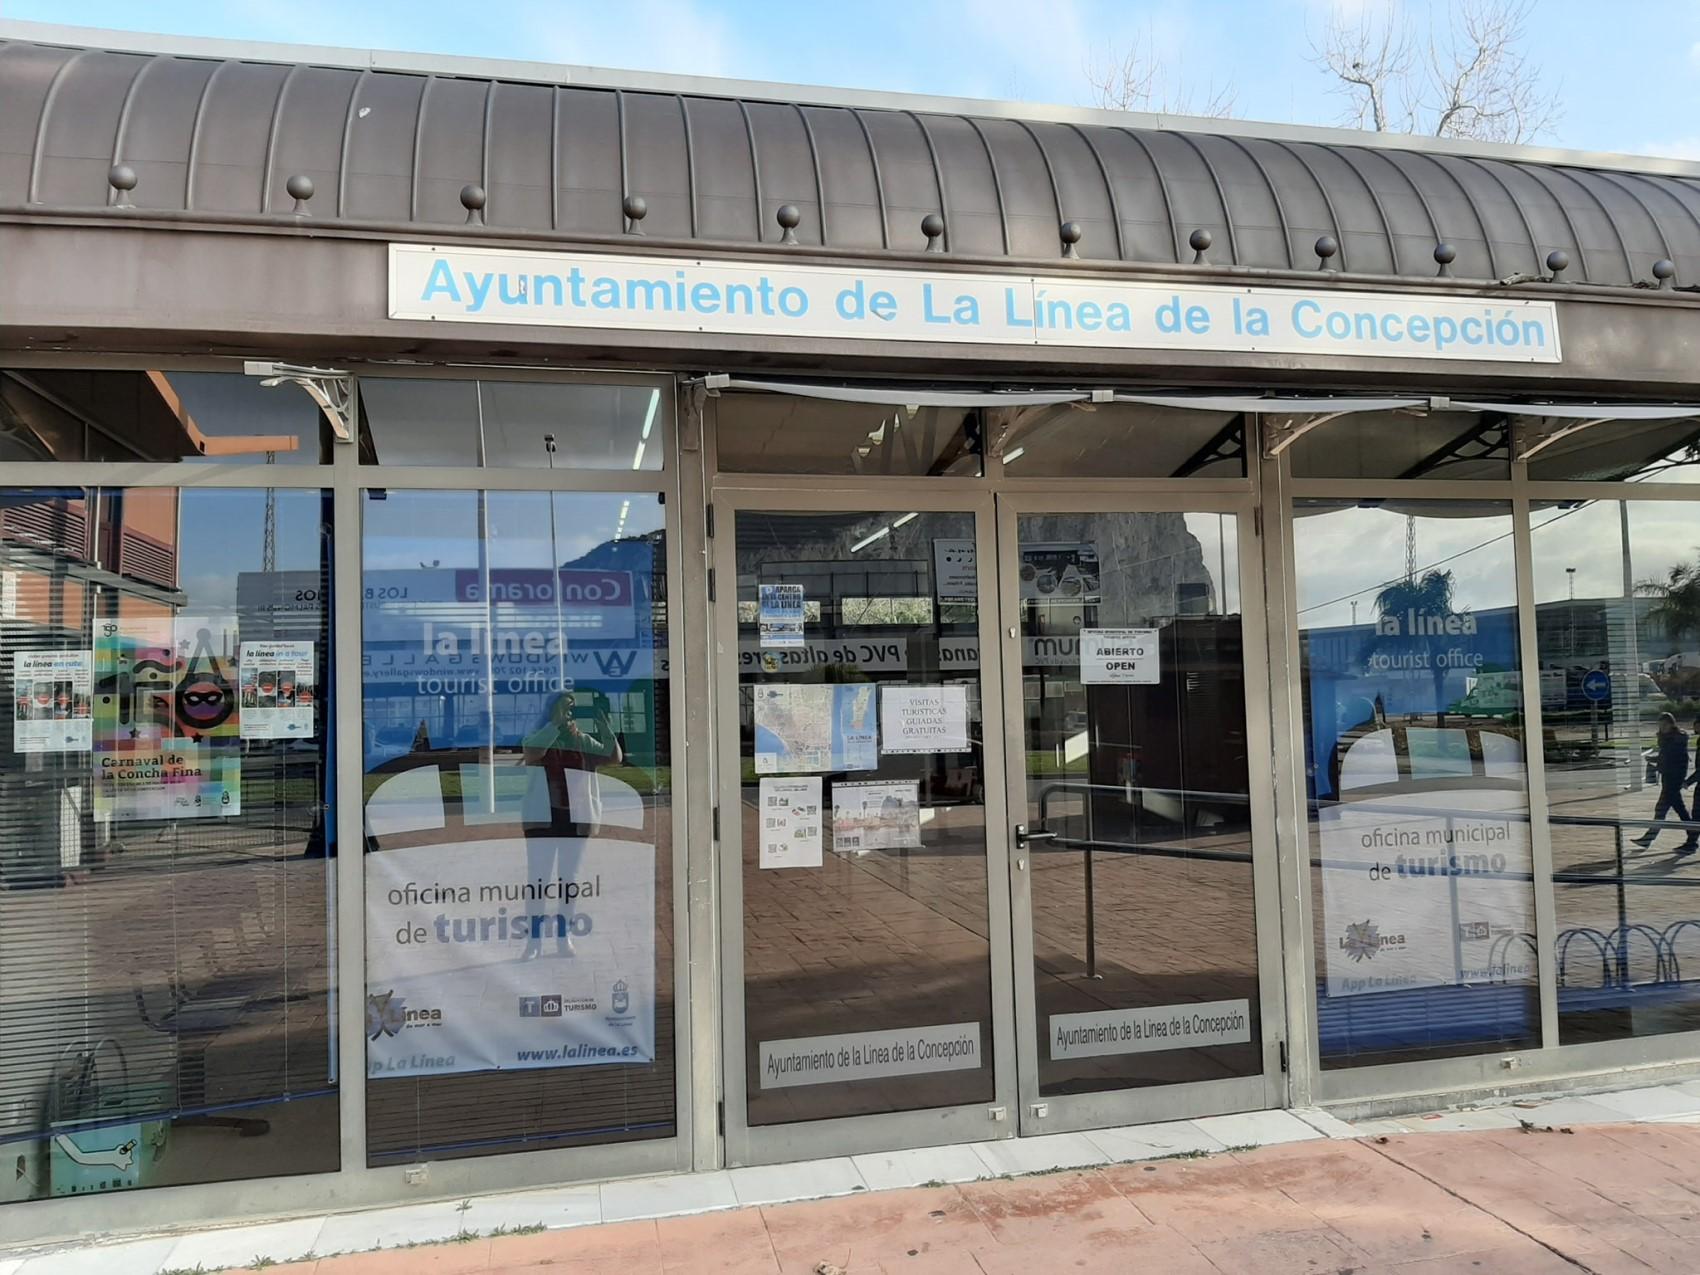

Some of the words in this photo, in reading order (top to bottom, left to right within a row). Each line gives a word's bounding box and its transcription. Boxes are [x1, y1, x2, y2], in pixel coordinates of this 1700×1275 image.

[420, 258, 810, 312] Ayuntamiento
[835, 280, 899, 321] de
[923, 283, 979, 325] La
[1006, 287, 1132, 332] Línea
[1155, 295, 1211, 335] de
[1233, 298, 1270, 337] la
[1292, 299, 1546, 351] Concepción
[1408, 607, 1478, 635] línea
[423, 622, 458, 655] la
[1096, 648, 1144, 656] ABIERTO
[1372, 649, 1431, 668] tourist
[1436, 648, 1484, 667] office
[1106, 662, 1136, 671] OPEN
[415, 672, 498, 694] tourist
[508, 670, 575, 693] office
[902, 727, 946, 735] GRATUITAS
[906, 718, 942, 726] GUIADAS
[101, 755, 164, 767] Carnaval
[167, 754, 184, 765] de
[102, 769, 115, 780] la
[117, 768, 169, 779] Concha
[172, 767, 202, 777] Fina
[1361, 828, 1421, 848] oficina
[1426, 822, 1511, 846] municipal
[1369, 862, 1391, 881] de
[1395, 848, 1507, 878] turismo
[387, 883, 471, 906] oficina
[480, 875, 601, 904] municipal
[396, 921, 427, 944] de
[433, 907, 593, 943] turismo
[563, 1003, 597, 1012] TURISMO
[1057, 1024, 1118, 1051] Ayuntamiento
[1120, 1021, 1132, 1041] de
[1133, 1020, 1142, 1039] la
[1170, 1015, 1181, 1036] de
[1182, 1015, 1191, 1035] la
[1192, 1010, 1244, 1036] Concepción
[517, 1043, 639, 1061] www.lalinea.es
[767, 1053, 835, 1080] Ayuntamiento
[837, 1047, 850, 1067] de
[852, 1046, 861, 1065] la
[892, 1041, 905, 1062] de
[906, 1040, 915, 1060] la
[917, 1035, 974, 1062] Concepción
